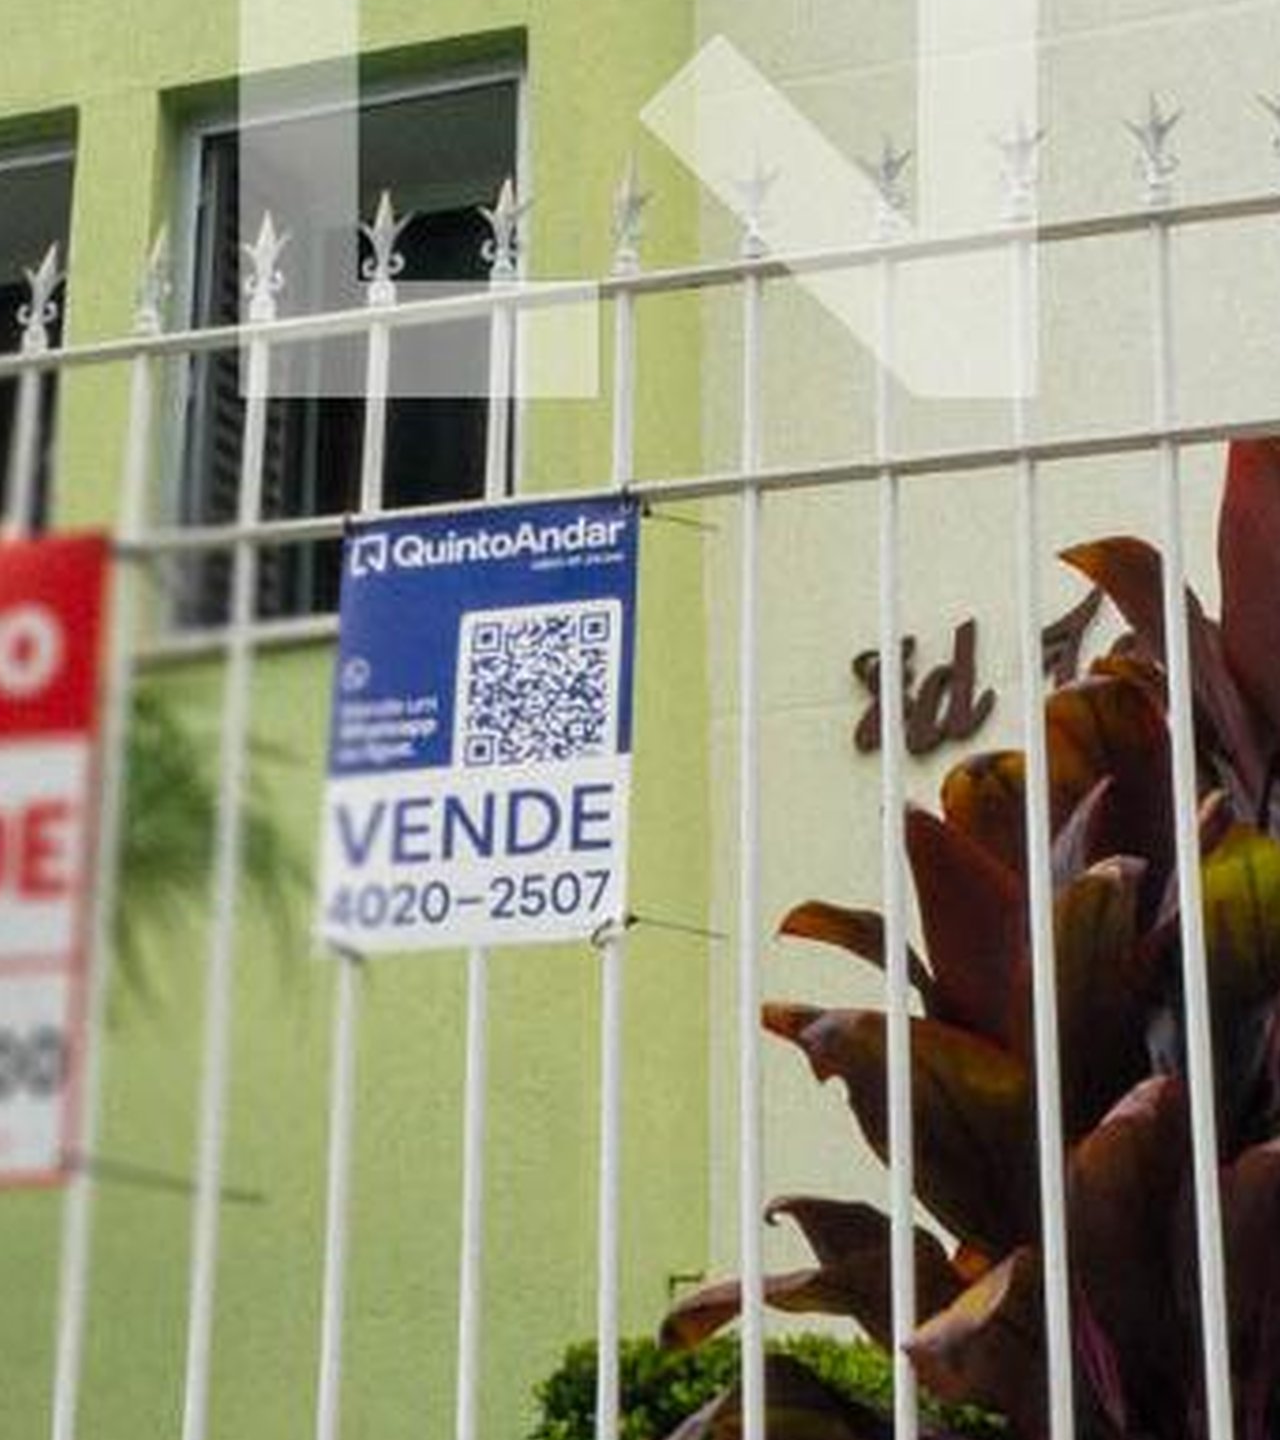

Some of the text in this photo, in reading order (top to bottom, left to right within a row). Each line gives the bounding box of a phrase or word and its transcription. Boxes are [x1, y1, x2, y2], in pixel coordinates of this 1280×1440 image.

[392, 516, 626, 567] QuintoAndar
[334, 783, 615, 870] VENDE
[327, 869, 612, 930] 4020-2507
